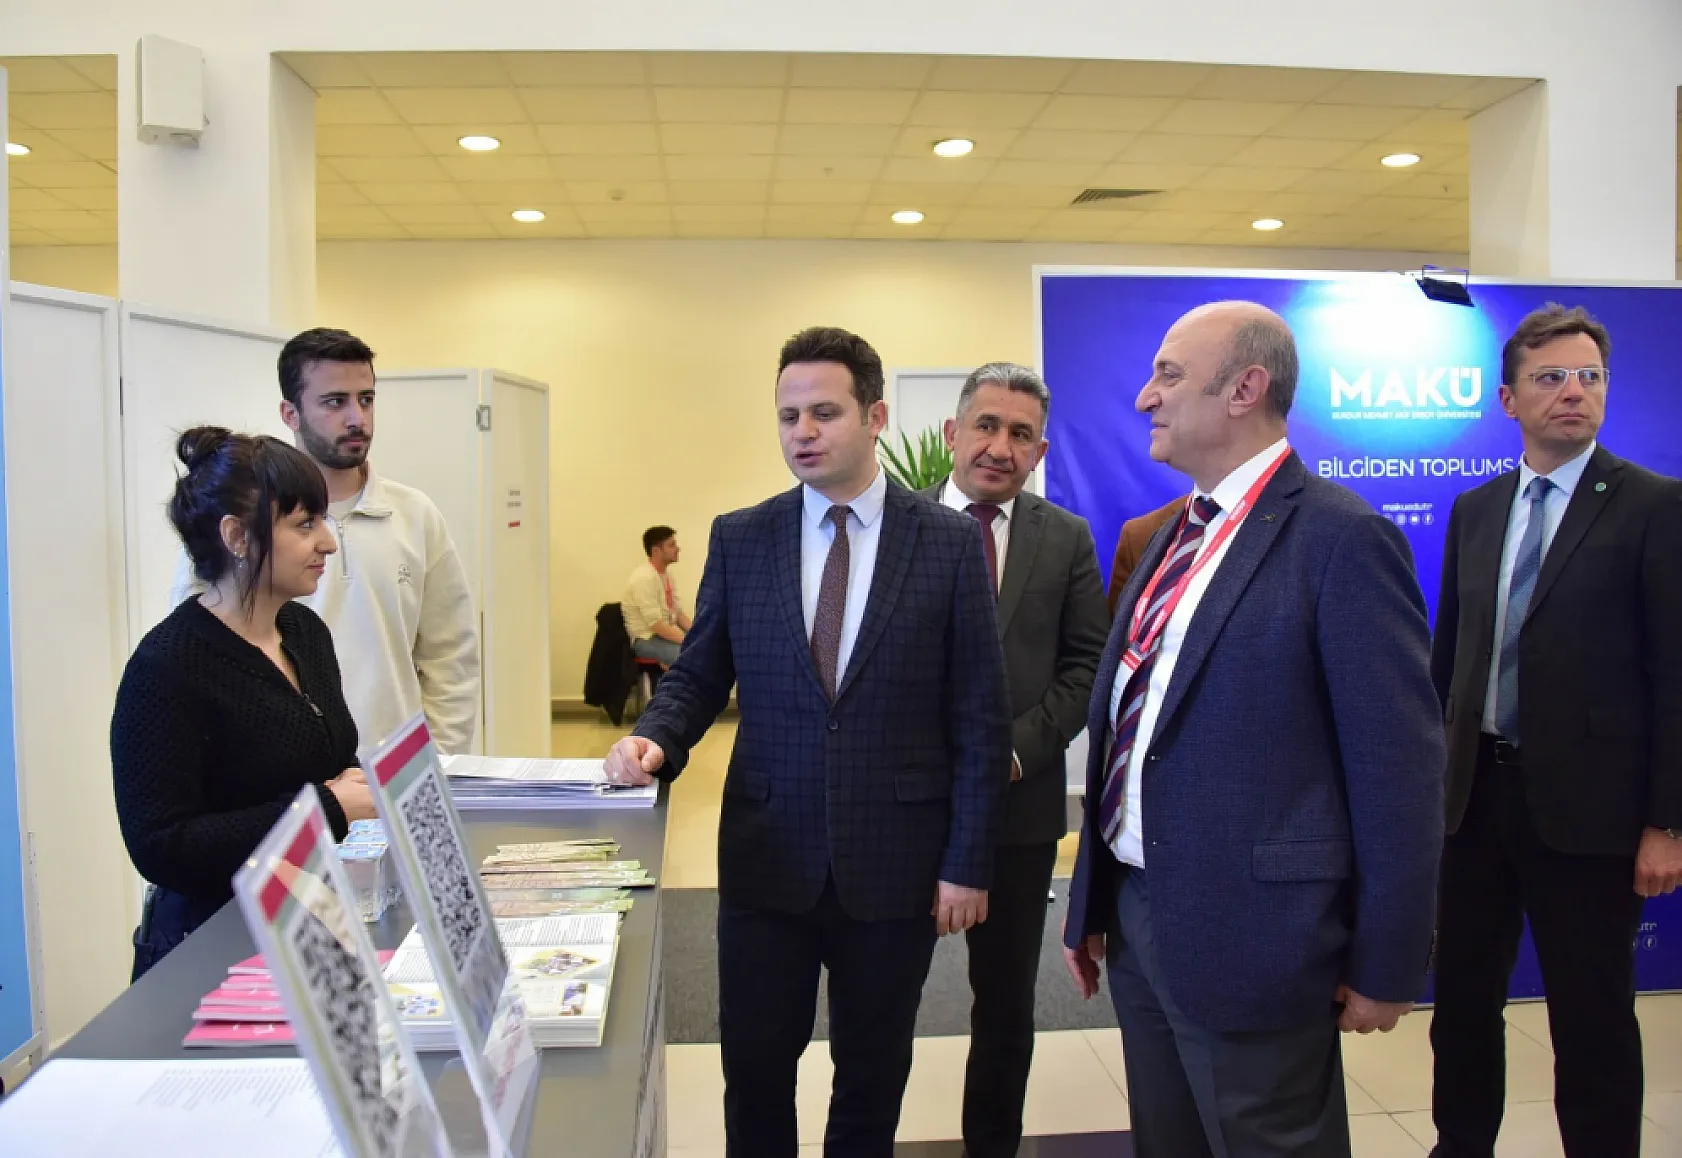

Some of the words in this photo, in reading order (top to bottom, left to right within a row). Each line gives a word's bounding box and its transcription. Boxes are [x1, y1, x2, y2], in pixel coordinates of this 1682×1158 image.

[1330, 366, 1482, 408] MAKÜ
[1318, 456, 1415, 478] BİLGİDEN
[1419, 457, 1520, 477] TOPLUMS
